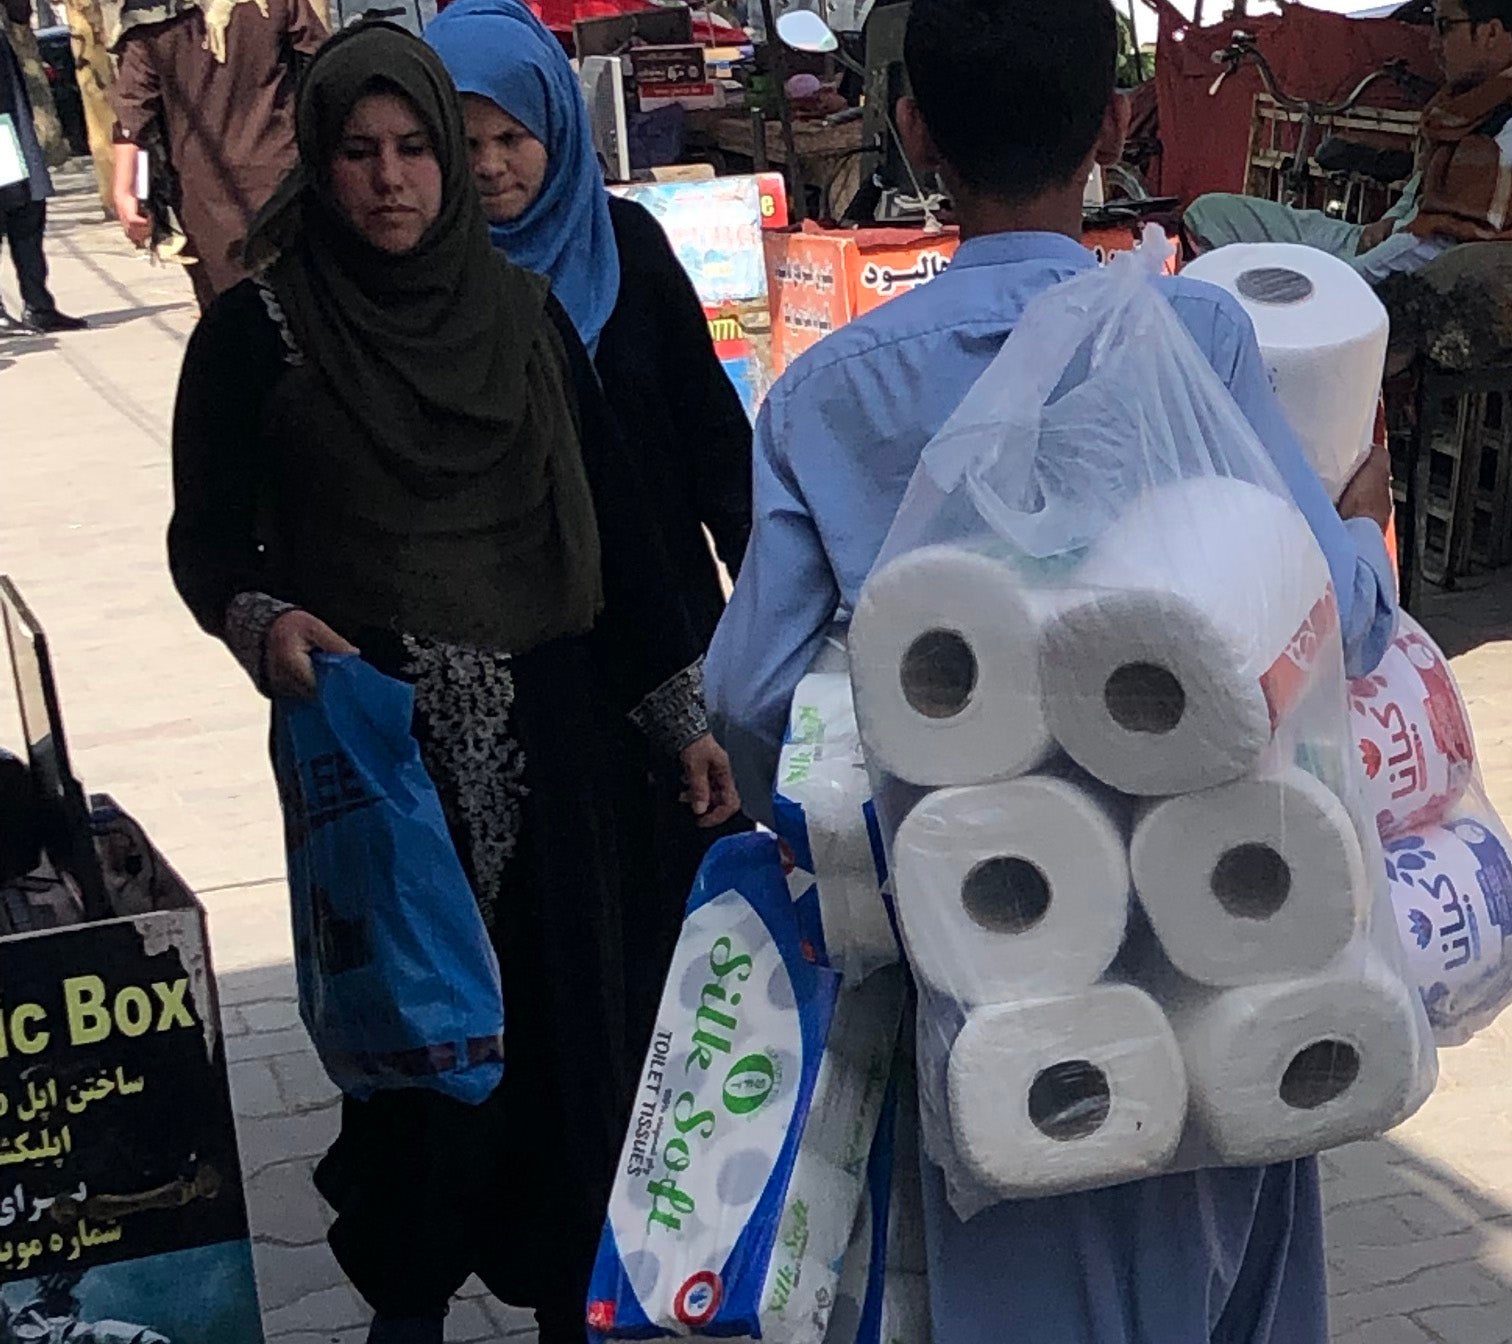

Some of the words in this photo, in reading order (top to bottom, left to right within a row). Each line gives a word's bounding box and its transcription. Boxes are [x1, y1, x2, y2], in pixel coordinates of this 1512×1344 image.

[1368, 702, 1420, 800] کیانا
[1417, 873, 1473, 971] کیانا
[64, 975, 196, 1046] Box
[686, 935, 753, 1075] Silk
[17, 1078, 58, 1122] اپل
[66, 1066, 145, 1113] ساختن
[647, 1030, 673, 1096] TOILET
[627, 1101, 657, 1178] TISSUES
[647, 1091, 716, 1235] Soft
[49, 1217, 123, 1261] شماره
